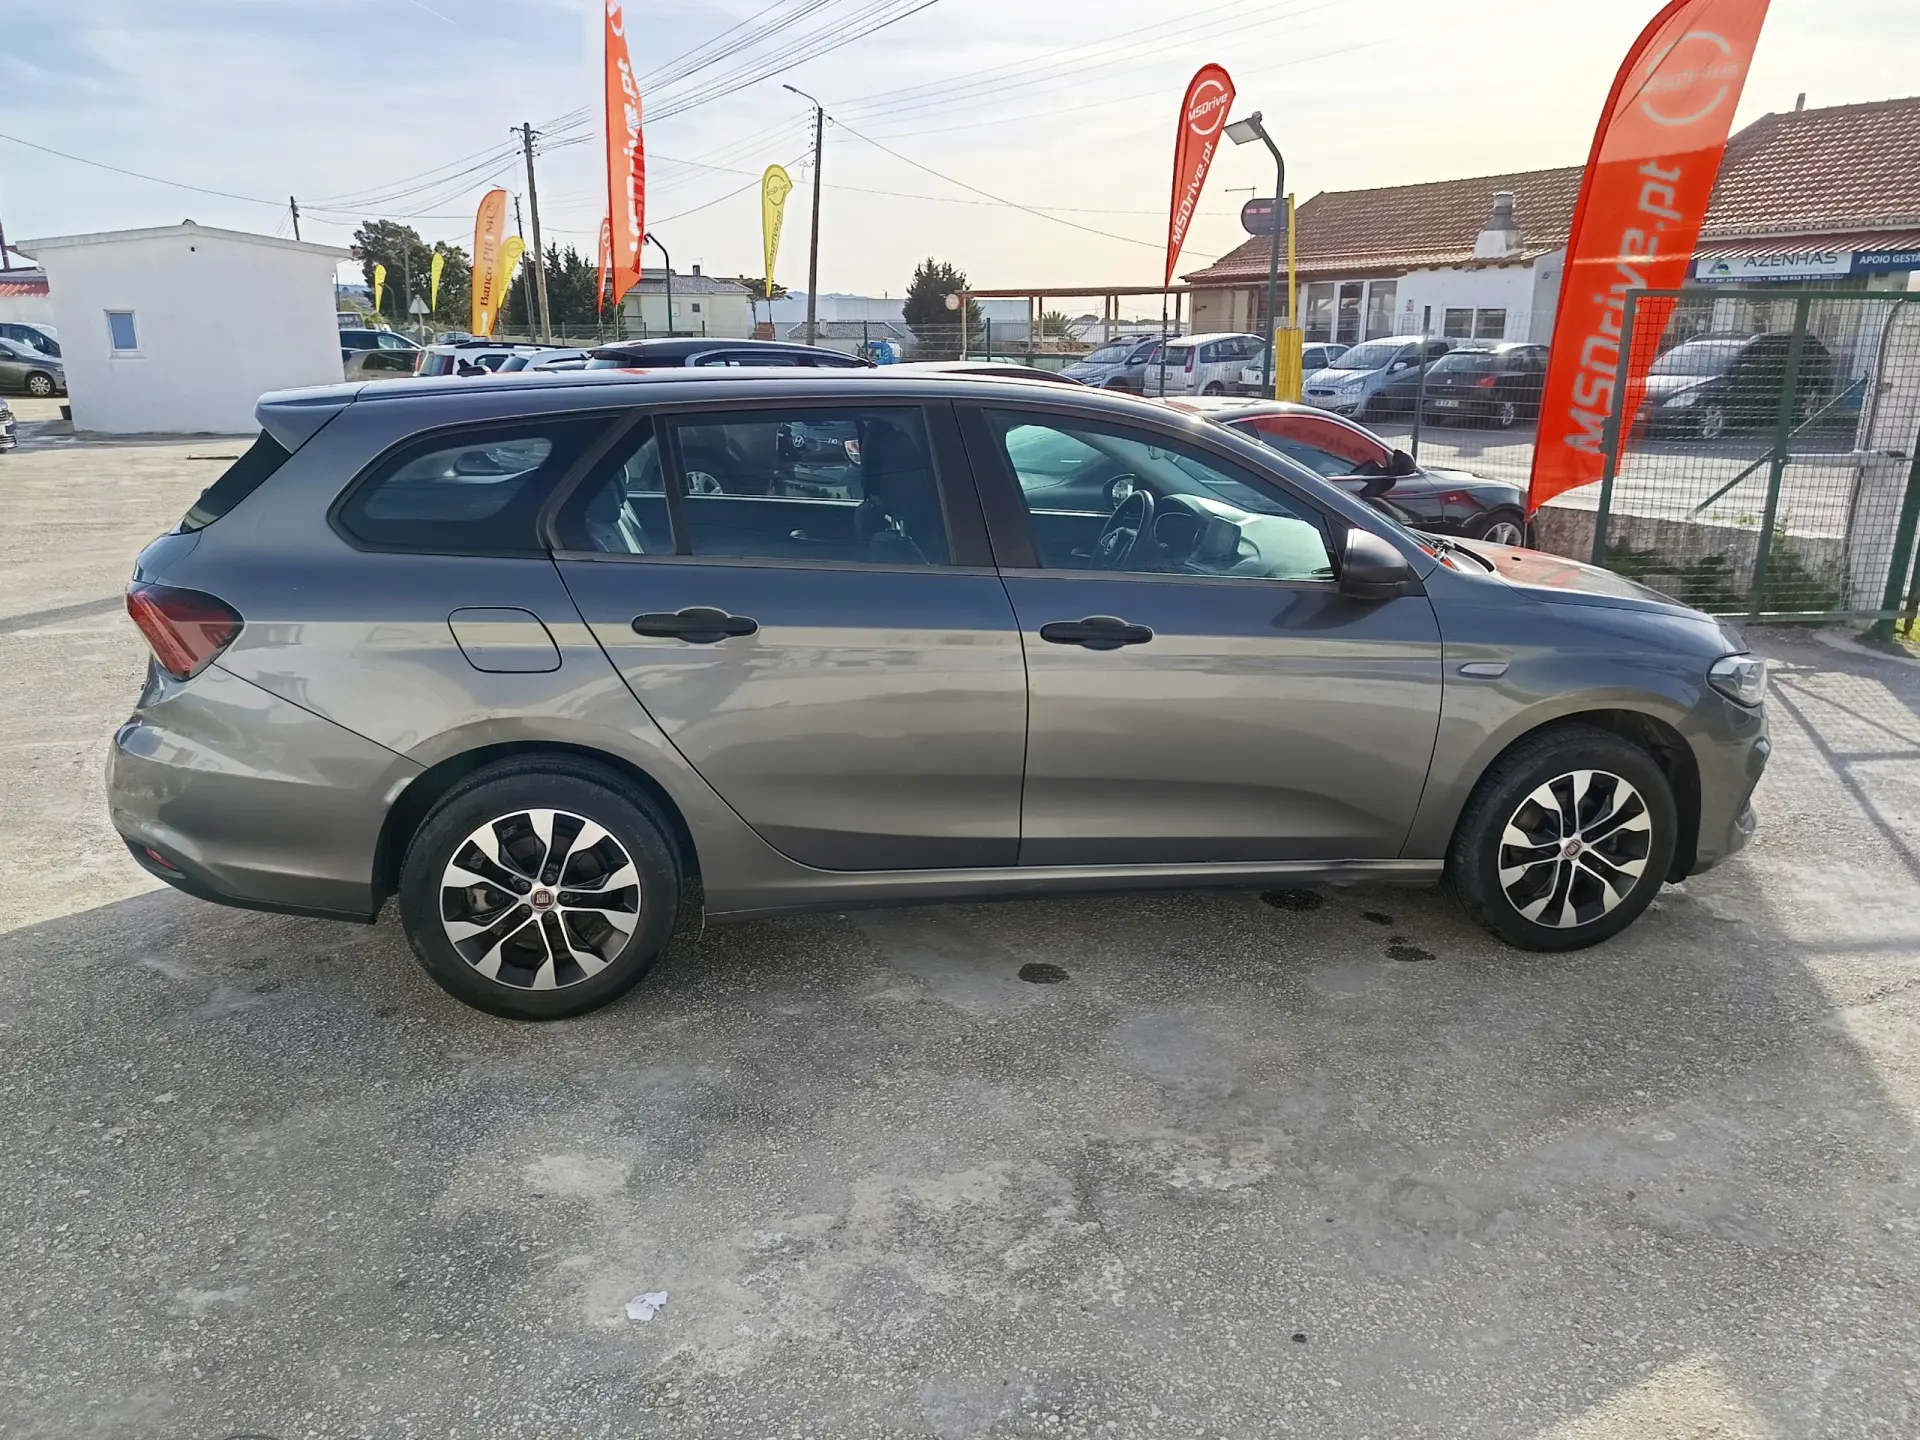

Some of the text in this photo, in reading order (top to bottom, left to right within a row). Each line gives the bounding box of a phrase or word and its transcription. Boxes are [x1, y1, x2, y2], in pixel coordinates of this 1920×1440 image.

[1188, 93, 1228, 122] MSDrive
[1172, 141, 1214, 245] MSDrive.pt
[1744, 252, 1838, 267] AZENHAS
[1859, 254, 1890, 265] APOIO
[480, 267, 493, 306] Banco
[1563, 161, 1682, 455] MSDrive.pt
